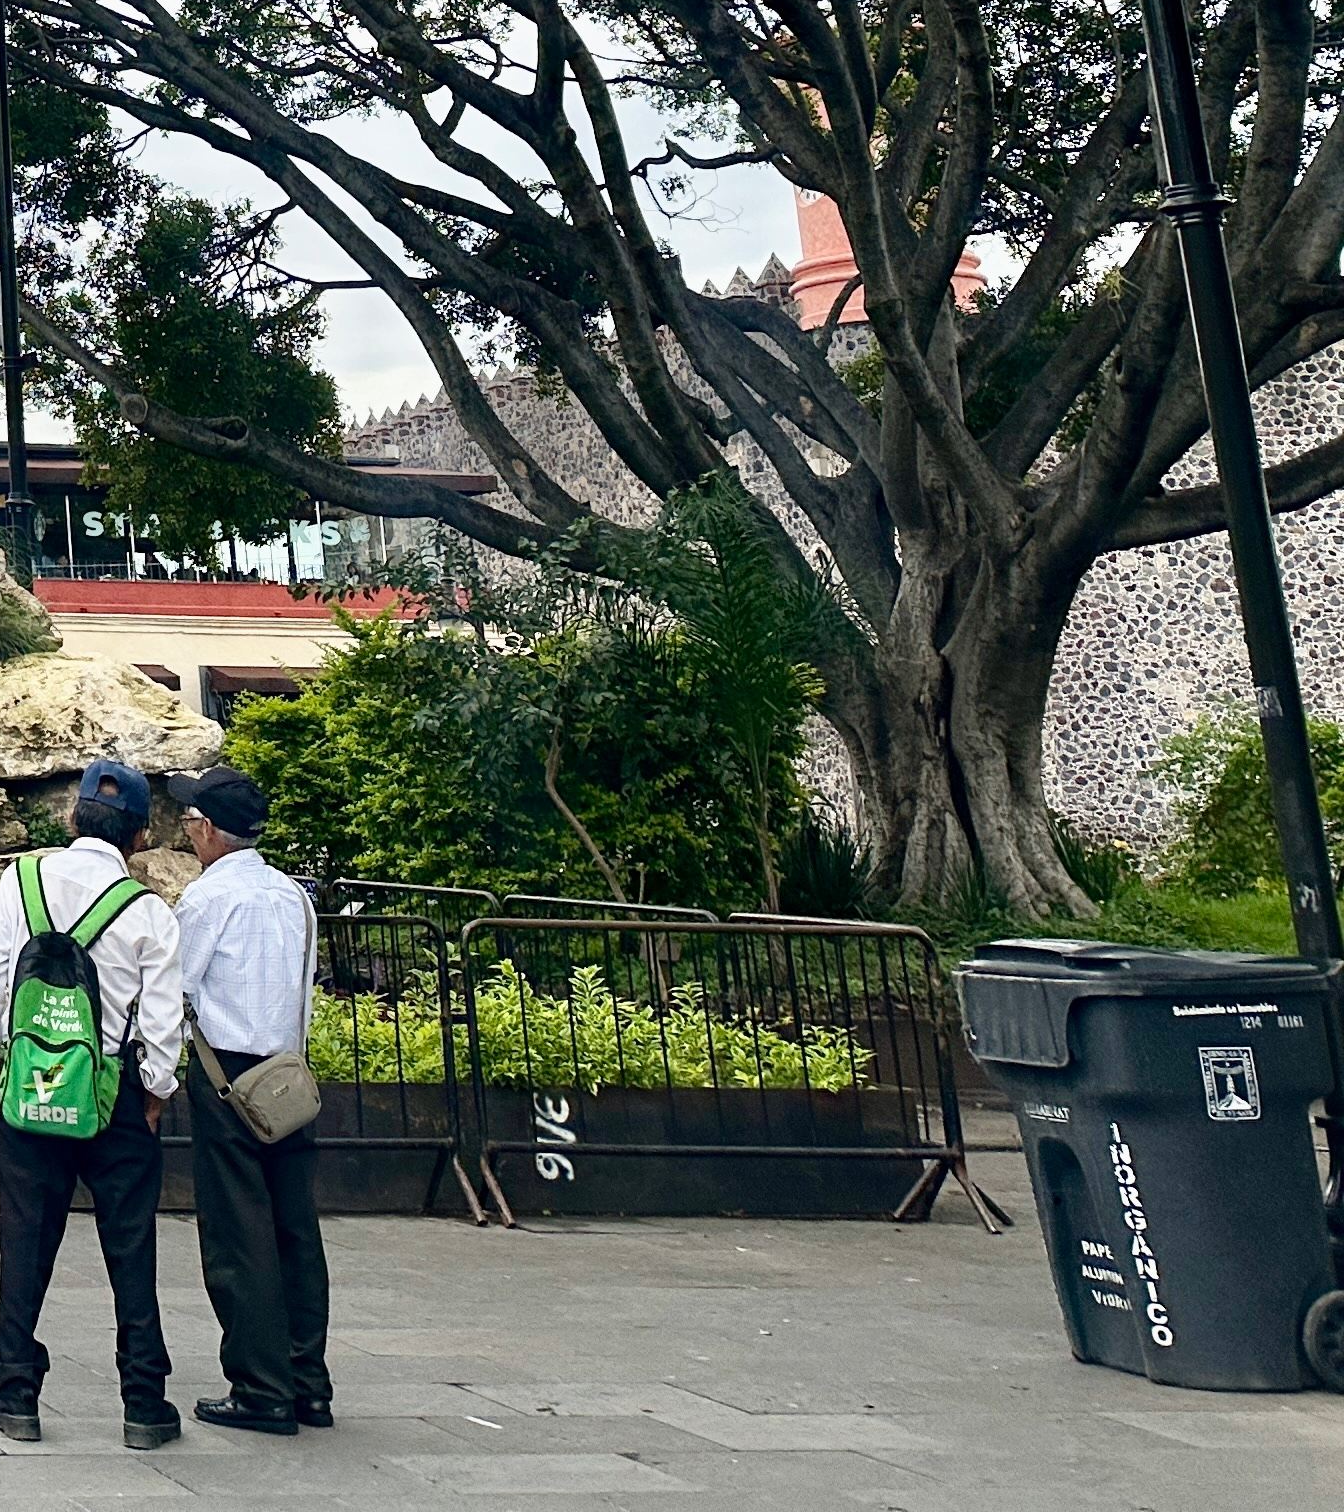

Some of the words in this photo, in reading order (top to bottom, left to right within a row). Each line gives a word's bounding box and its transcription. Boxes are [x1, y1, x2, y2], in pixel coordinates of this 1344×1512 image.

[82, 510, 343, 546] STBKS
[43, 990, 57, 1006] La
[60, 995, 76, 1008] 4T
[32, 1013, 49, 1028] de
[50, 1008, 79, 1019] pinta
[18, 1098, 79, 1125] VERDE
[1109, 1122, 1174, 1347] INORGANICO
